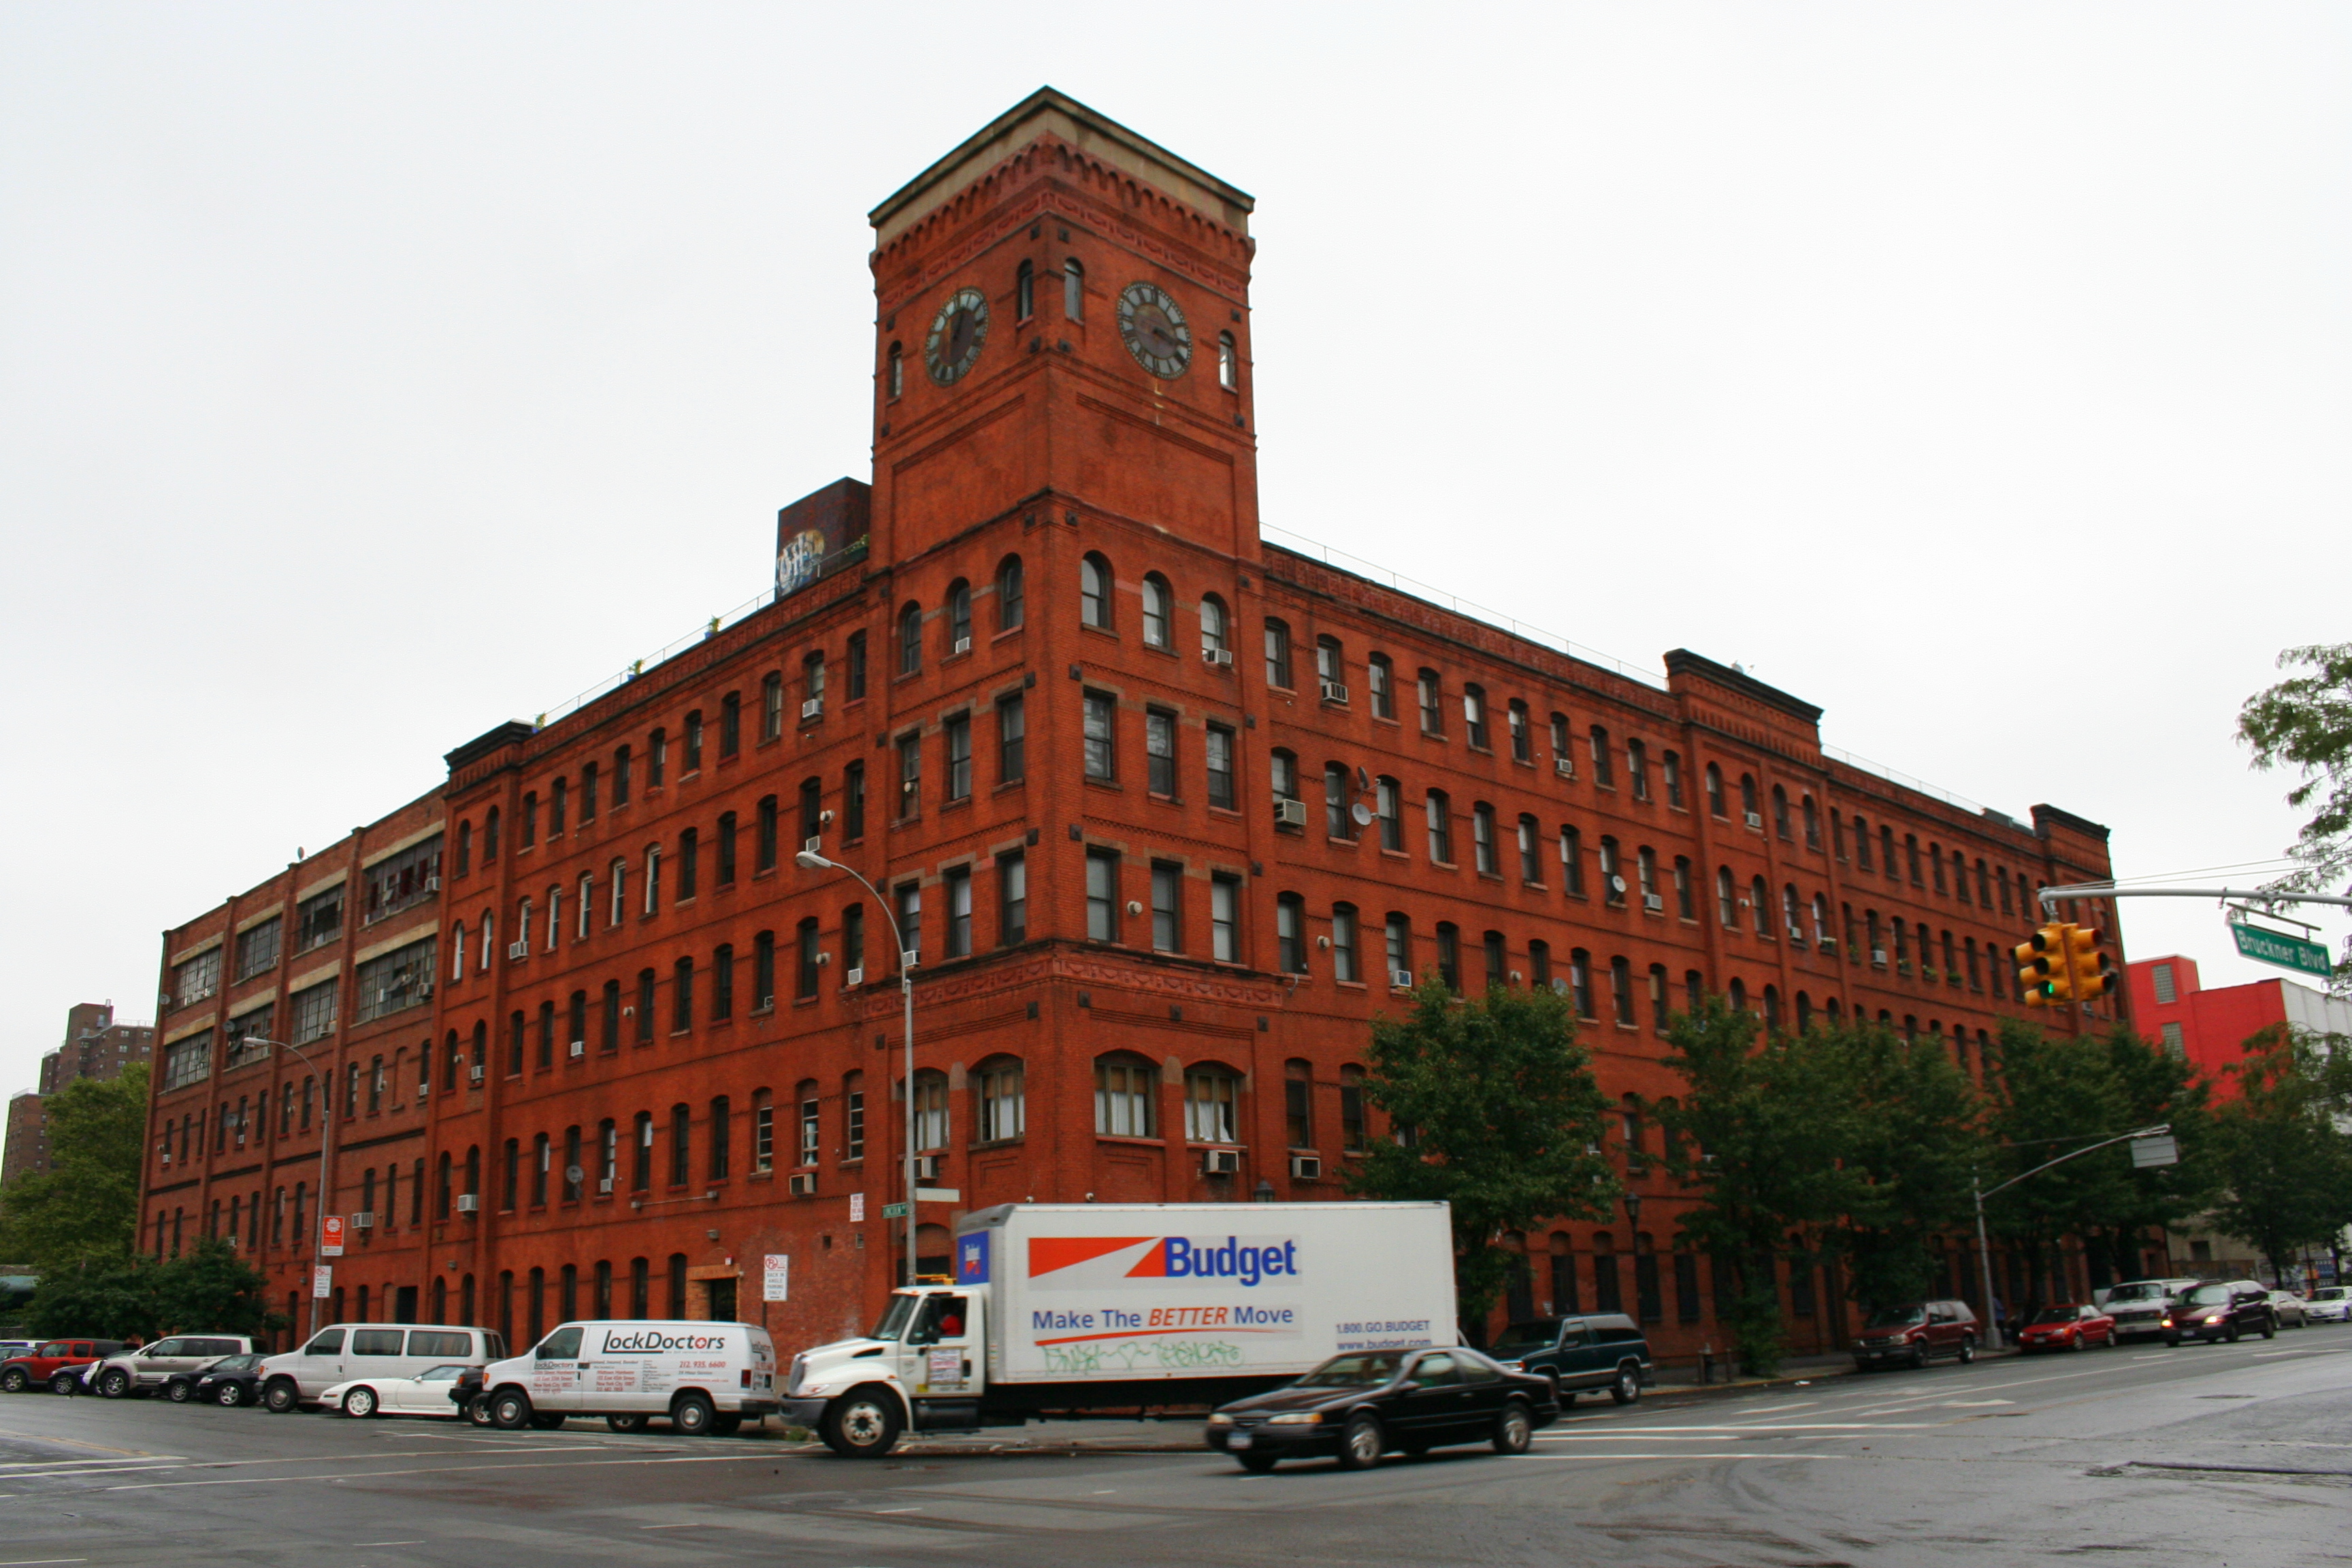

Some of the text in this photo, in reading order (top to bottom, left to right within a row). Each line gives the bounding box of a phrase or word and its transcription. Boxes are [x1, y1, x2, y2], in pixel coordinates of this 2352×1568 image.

[2236, 929, 2328, 971] Bruckner Blvd
[1164, 1235, 1296, 1287] Budget
[1032, 1306, 1294, 1329] Make The BETTER Move
[602, 1330, 725, 1354] LockDoctors
